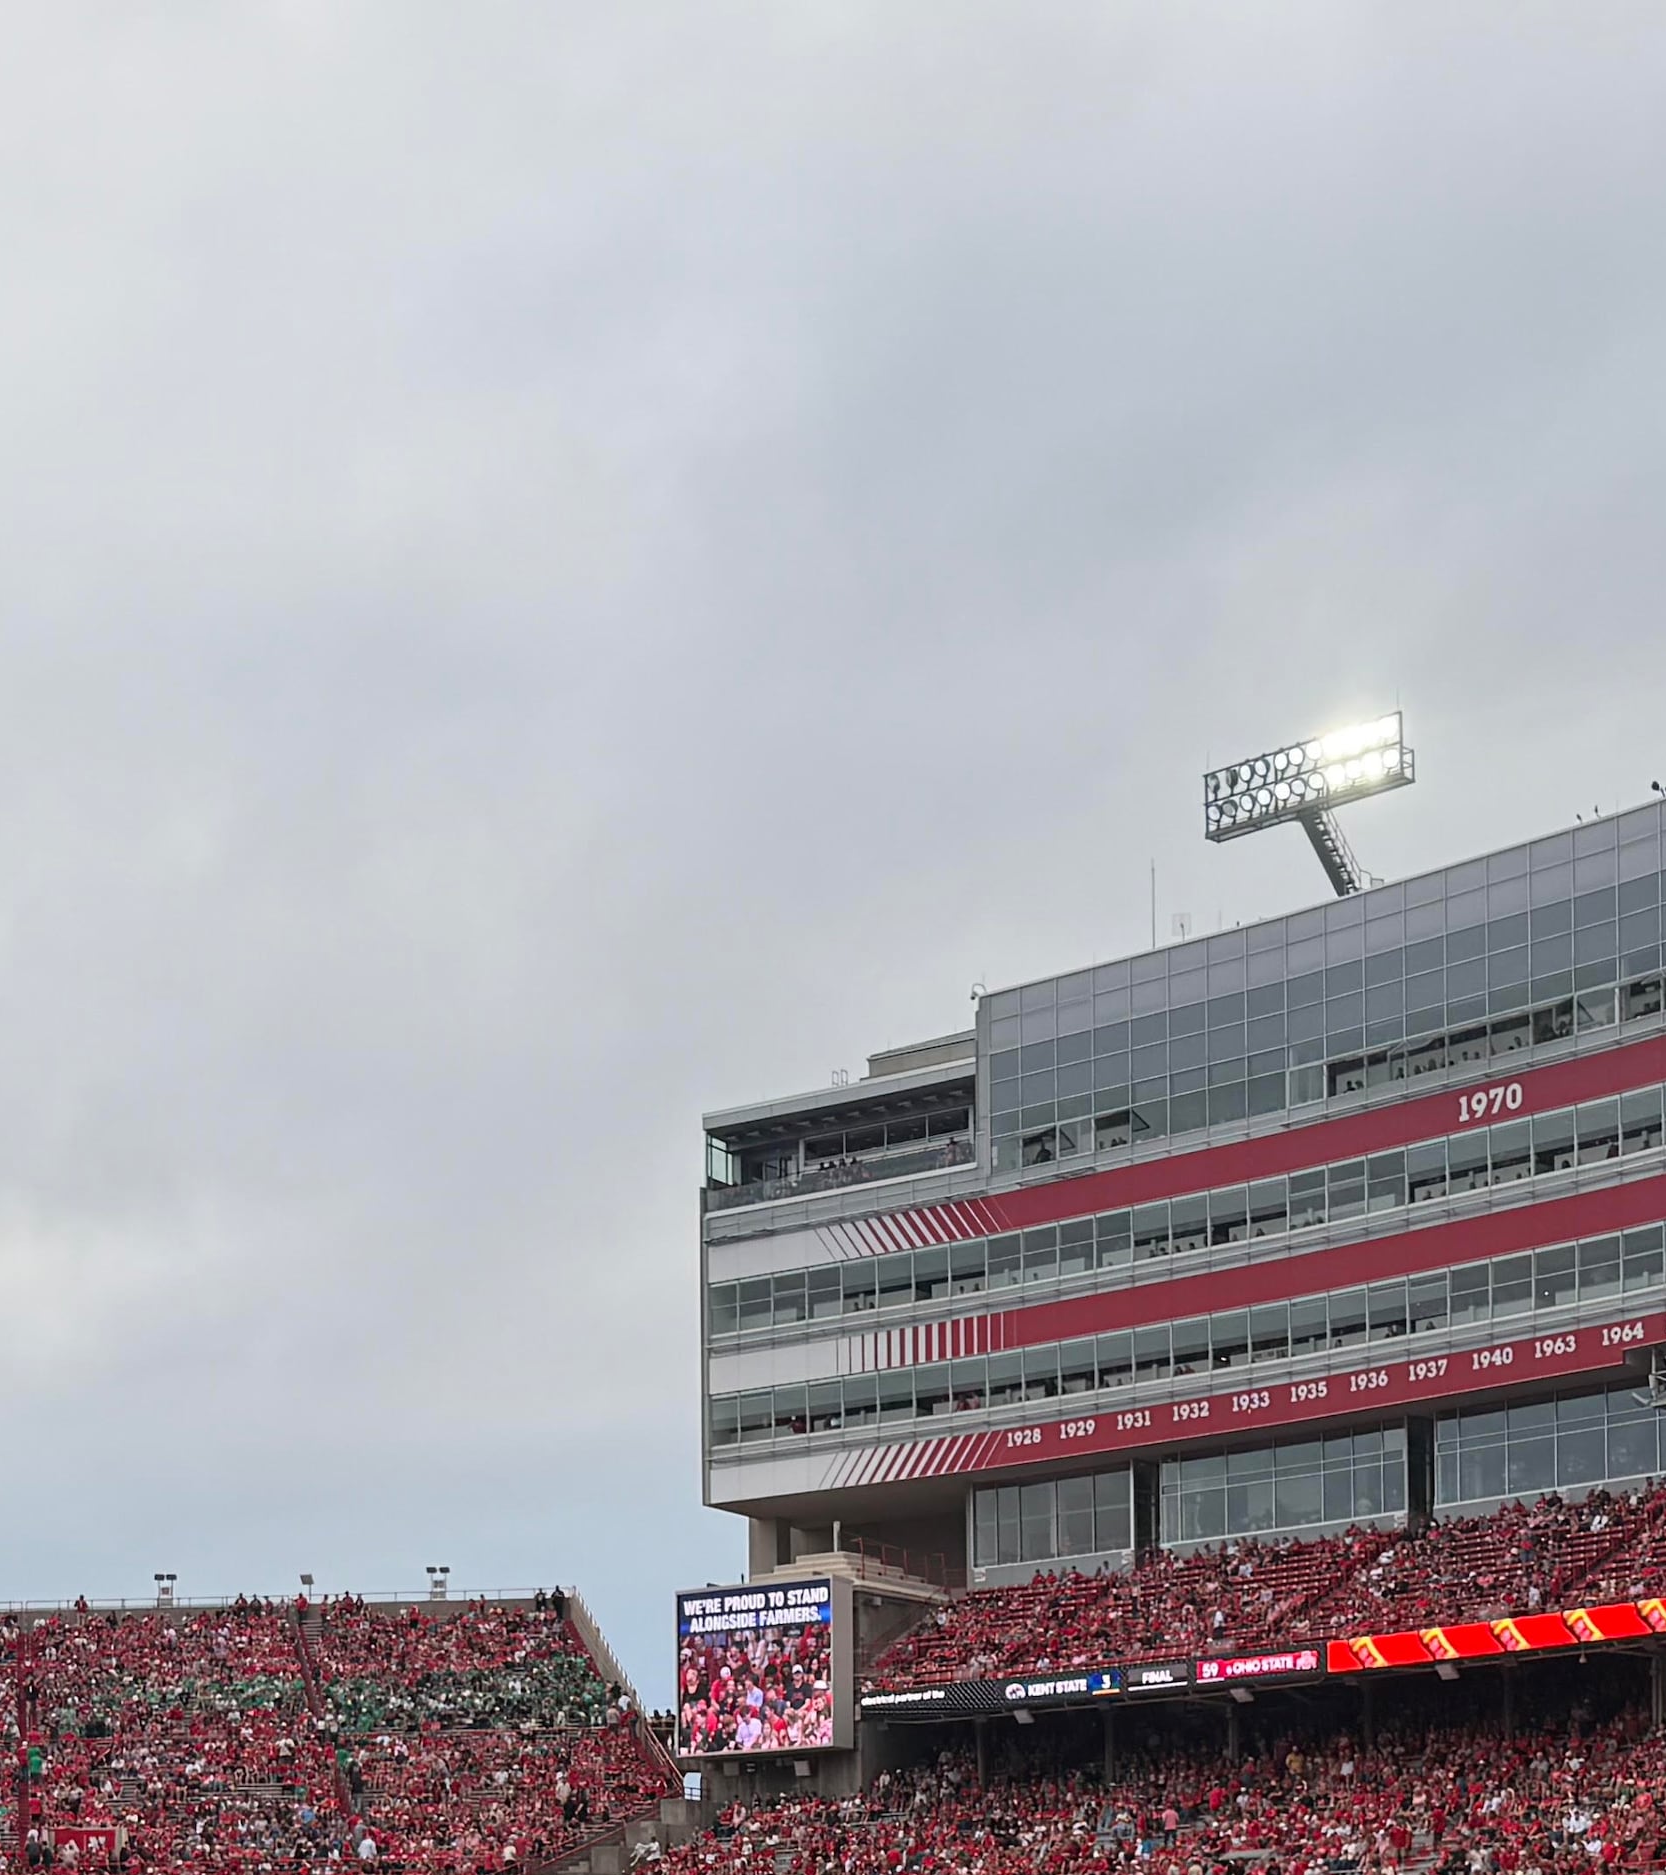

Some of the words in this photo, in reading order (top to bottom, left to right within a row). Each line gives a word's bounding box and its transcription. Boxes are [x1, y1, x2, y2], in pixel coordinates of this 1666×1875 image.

[1458, 1083, 1523, 1122] 1970
[1007, 1427, 1042, 1448] 1928
[1059, 1420, 1095, 1439] 1929
[1116, 1410, 1152, 1431] 1931
[1172, 1401, 1210, 1422] 1932
[1232, 1391, 1270, 1412] 1933
[1290, 1381, 1328, 1403] 1935
[1349, 1370, 1388, 1392] 1936
[1408, 1358, 1448, 1382] 1937
[1472, 1348, 1514, 1371] 1940
[1534, 1335, 1576, 1359] 1963
[1601, 1321, 1644, 1346] 1964
[684, 1598, 721, 1616] WE'RE
[724, 1593, 765, 1612] PROUD
[768, 1590, 784, 1607] TO
[787, 1587, 829, 1606] STAND
[690, 1612, 756, 1633] ALONGSIDE
[759, 1606, 821, 1625] FARMERS.
[1142, 1670, 1173, 1685] FINAL
[1202, 1662, 1219, 1677] 59
[1233, 1659, 1259, 1675] OHIO
[1260, 1656, 1293, 1672] STATE
[1028, 1683, 1055, 1696] KENT
[1056, 1679, 1087, 1695] STATE
[1102, 1675, 1110, 1688] 3
